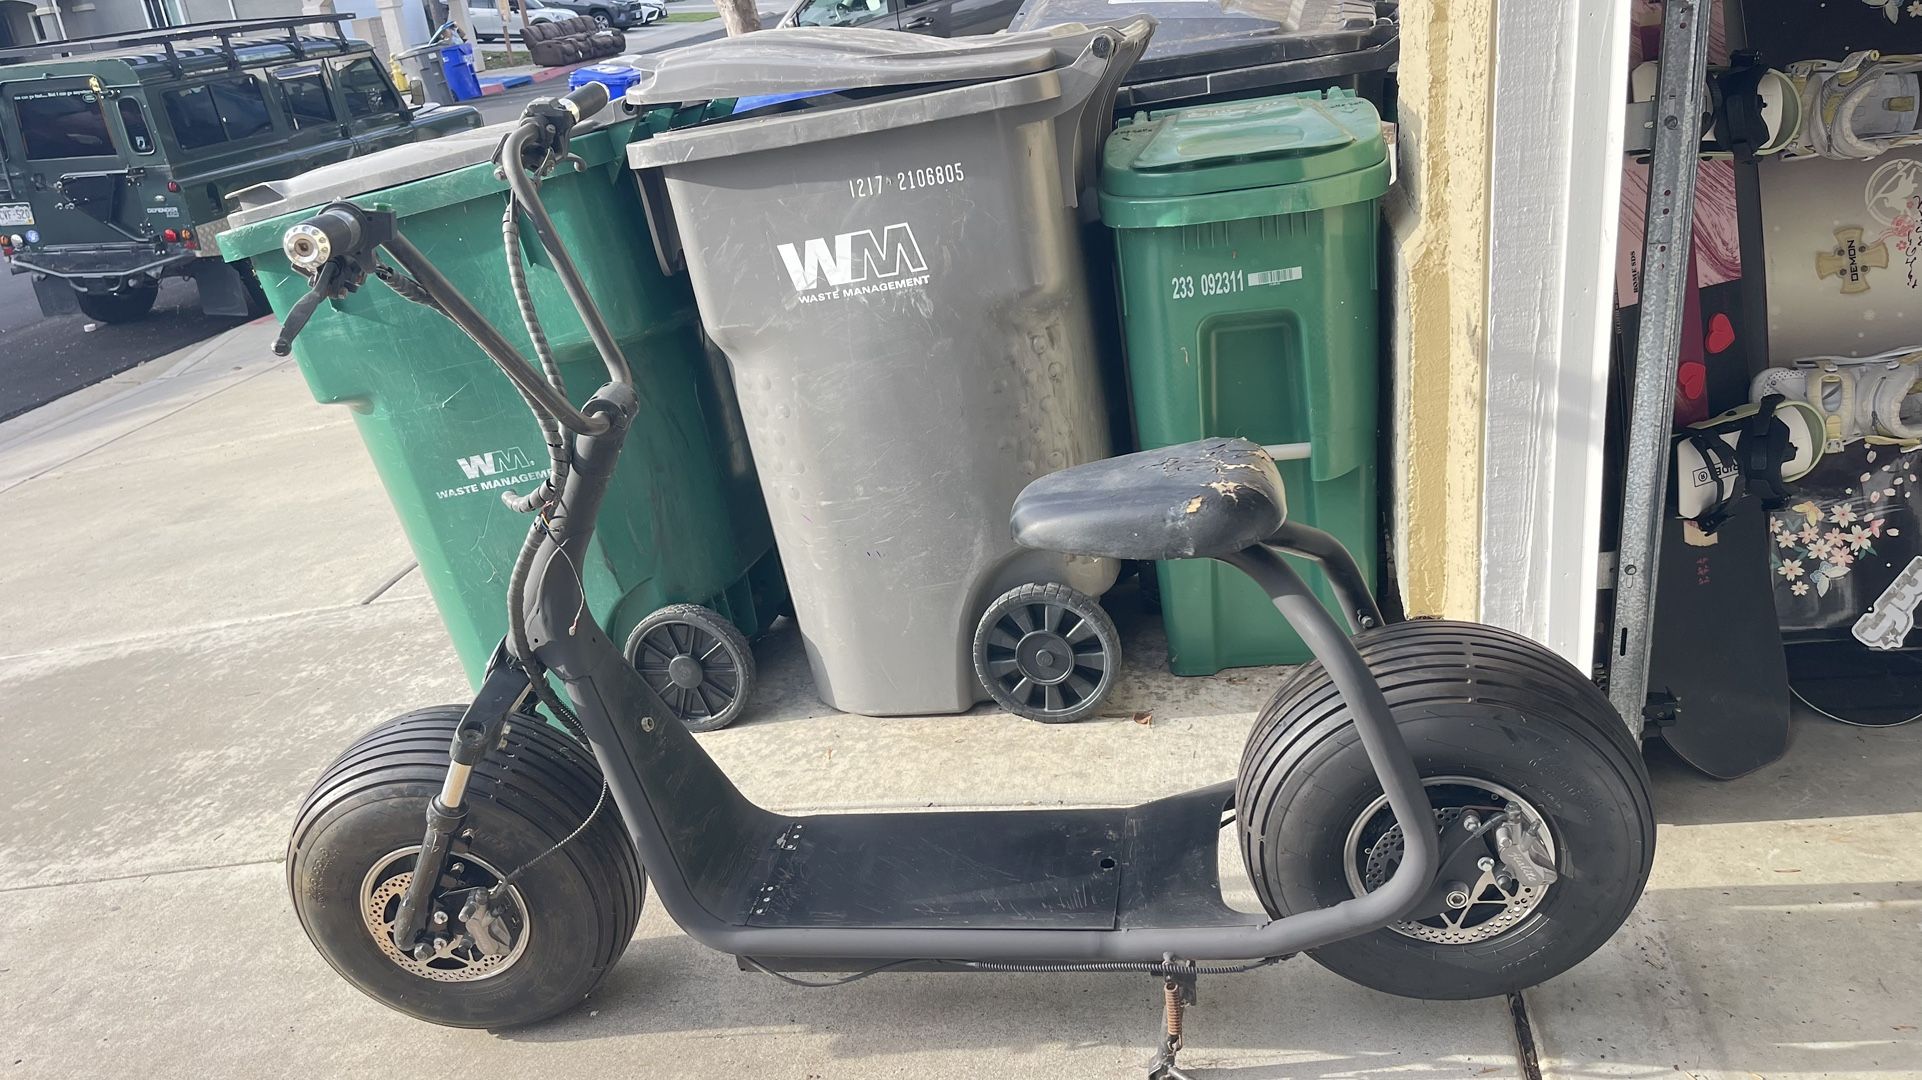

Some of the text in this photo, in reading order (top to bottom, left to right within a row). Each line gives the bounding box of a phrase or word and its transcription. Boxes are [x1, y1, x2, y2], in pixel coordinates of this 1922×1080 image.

[849, 162, 964, 199] 1217 2106805
[776, 222, 928, 291] WM
[1847, 239, 1859, 282] DEMON
[798, 275, 930, 304] WASTE MANAGEMENT
[1171, 269, 1244, 300] 233 092311
[1631, 268, 1639, 294] ROME
[456, 446, 531, 480] WM
[436, 483, 479, 500] WASTE
